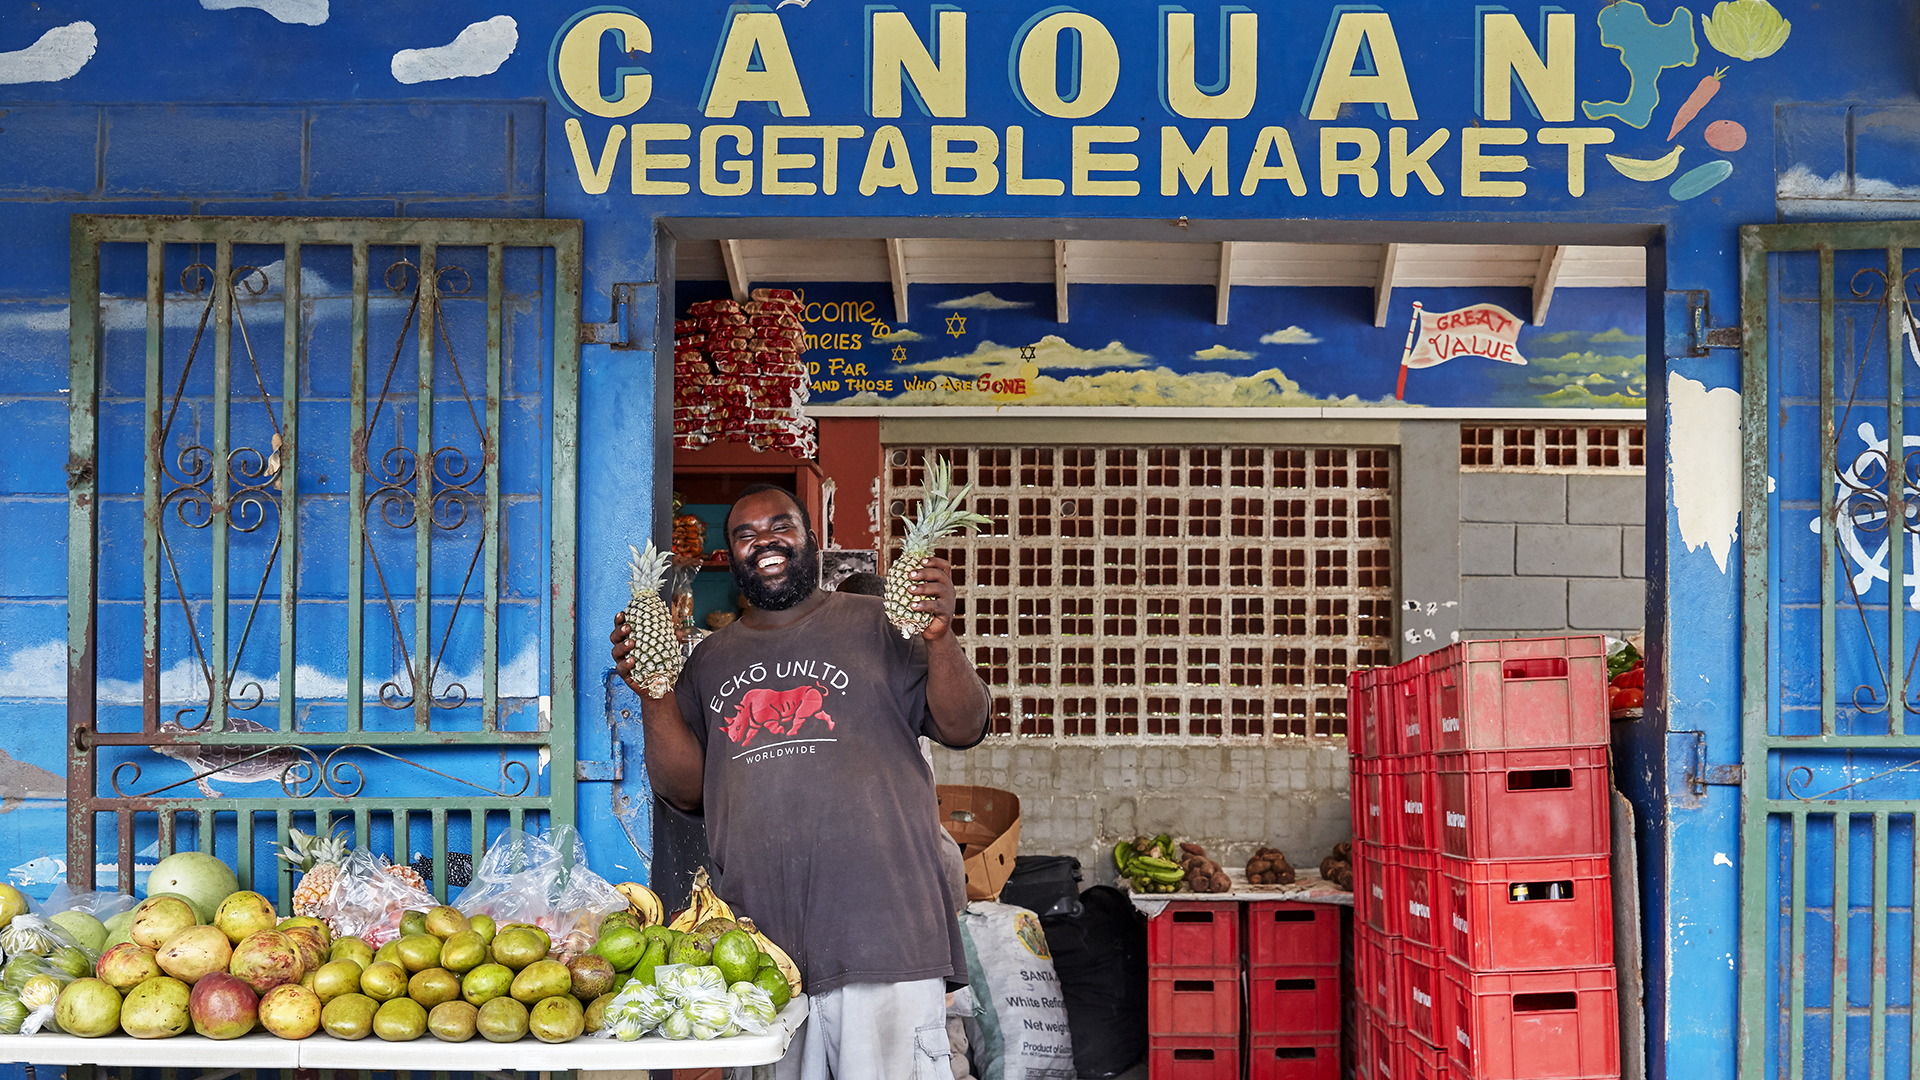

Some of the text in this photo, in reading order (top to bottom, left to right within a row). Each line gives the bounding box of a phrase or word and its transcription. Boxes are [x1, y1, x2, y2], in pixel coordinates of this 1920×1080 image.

[551, 8, 1576, 119] CANOUAN
[565, 118, 1616, 198] VEGETABLE MARKET
[797, 288, 890, 338] lcome to
[1436, 309, 1512, 333] GREAT
[1428, 334, 1514, 361] VALUE
[828, 358, 868, 376] FAR
[811, 373, 1027, 395] AND THOSE WHO ARE GONE
[776, 659, 850, 696] UNLTD.
[745, 745, 816, 765] WORLDWIDE
[1020, 970, 1055, 982] SANTA
[1006, 996, 1040, 1008] White
[1023, 1018, 1044, 1032] Net
[1023, 1041, 1053, 1054] Product
